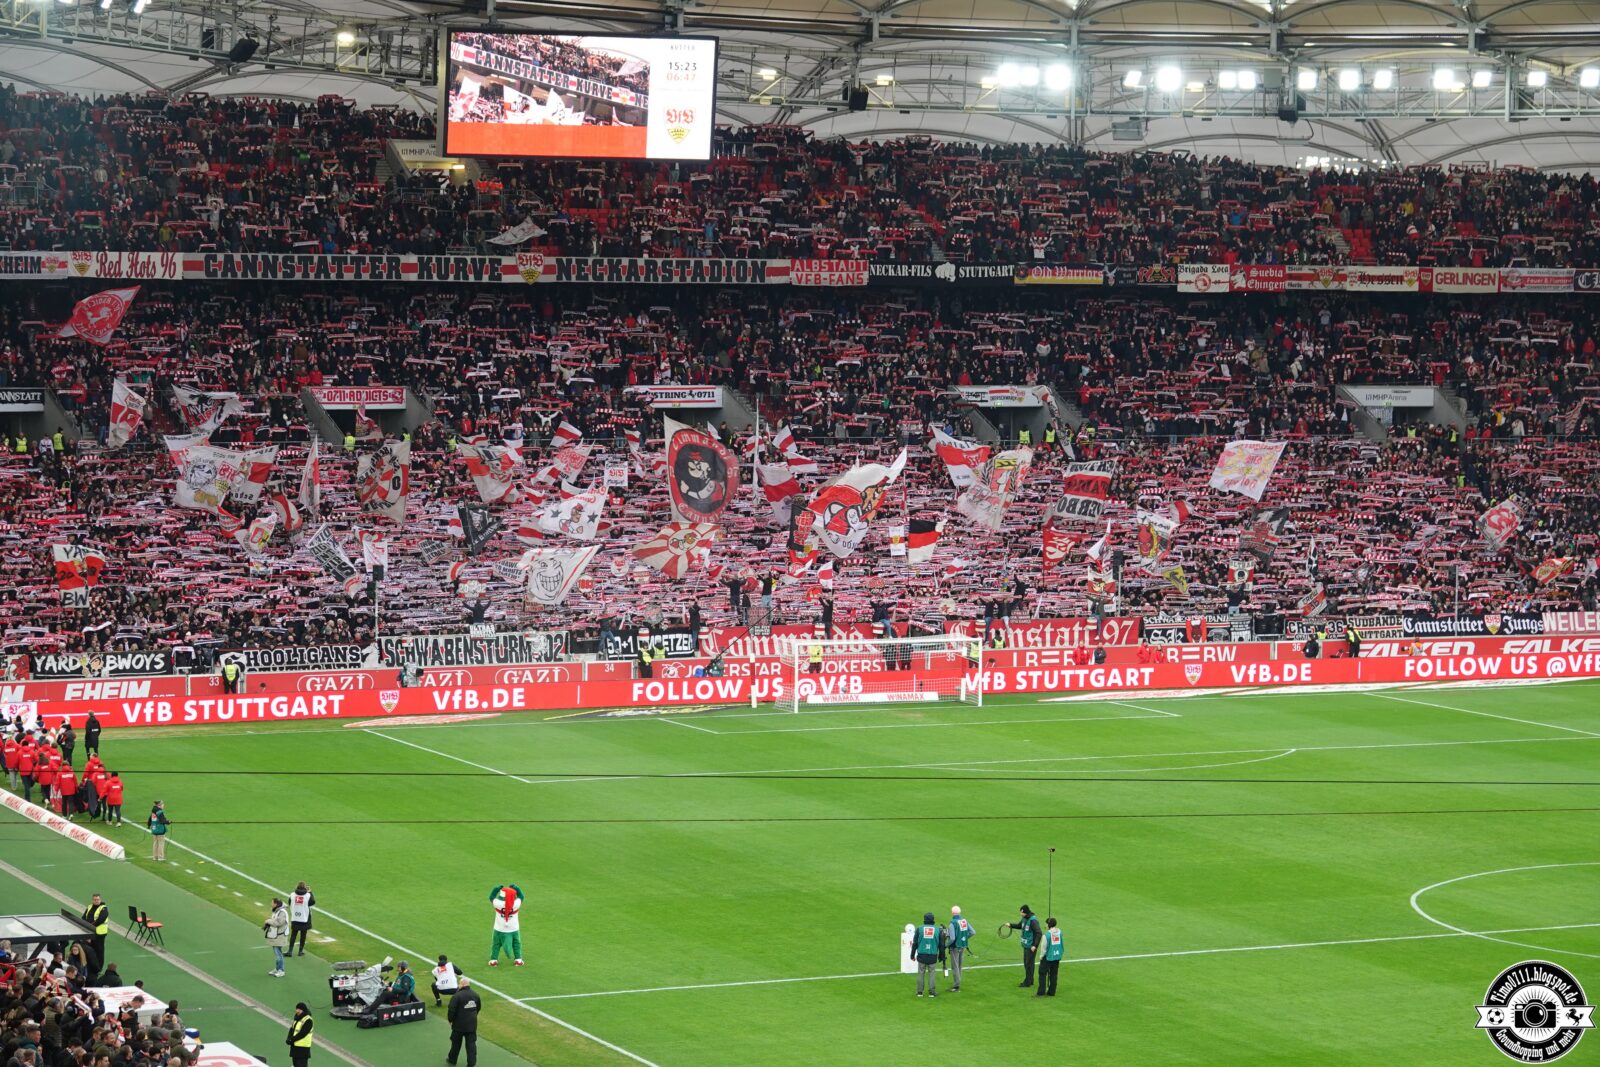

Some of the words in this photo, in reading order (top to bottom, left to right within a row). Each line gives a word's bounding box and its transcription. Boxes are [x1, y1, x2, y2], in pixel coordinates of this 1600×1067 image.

[668, 61, 698, 71] 15:23
[474, 50, 571, 89] CANNSTATTER
[575, 78, 613, 100] KURVE
[666, 73, 697, 81] 06:47
[665, 108, 695, 124] VfB
[0, 256, 41, 274] HEIM
[95, 250, 123, 279] Red
[126, 251, 157, 279] Hots
[160, 251, 177, 278] 96
[204, 254, 402, 279] CANNSTATTER
[417, 256, 503, 282] KURVE
[556, 257, 768, 283] NECKARSTADION
[793, 259, 866, 272] ALBSTADT
[869, 264, 932, 277] NECKAR-FILS
[959, 264, 1014, 278] STUTTGART
[1178, 264, 1208, 275] Brigada
[795, 272, 864, 285] VFB-FANS
[1031, 265, 1051, 279] Old
[1053, 266, 1104, 281] Warriors
[1435, 272, 1496, 287] GERLINGEN
[62, 591, 88, 606] BW
[1327, 621, 1344, 634] 36
[1404, 612, 1484, 635] Cannstatter
[1503, 612, 1544, 635] Jungs
[1103, 619, 1136, 647] 97
[1291, 643, 1301, 652] 36
[34, 654, 82, 675] YARD
[104, 653, 165, 672] BWOYS
[244, 645, 361, 668] HOOLIGANS
[946, 652, 956, 662] 35
[604, 663, 615, 673] 34
[1230, 663, 1312, 684] VfB.DE
[1405, 656, 1502, 678] FOLLOW
[1510, 655, 1538, 675] US
[208, 676, 220, 686] 33
[964, 671, 1006, 691] VfB
[1015, 667, 1154, 690] STUTTGART
[64, 680, 152, 701] EHEIM
[632, 679, 744, 702] FOLLOW
[752, 677, 784, 698] US
[797, 674, 863, 698] @VfB
[432, 687, 526, 711] VfB.DE
[822, 694, 860, 703] WINAMAX
[887, 693, 925, 702] WINAMAX
[122, 701, 172, 723] VfB
[184, 694, 345, 722] STUTTGART
